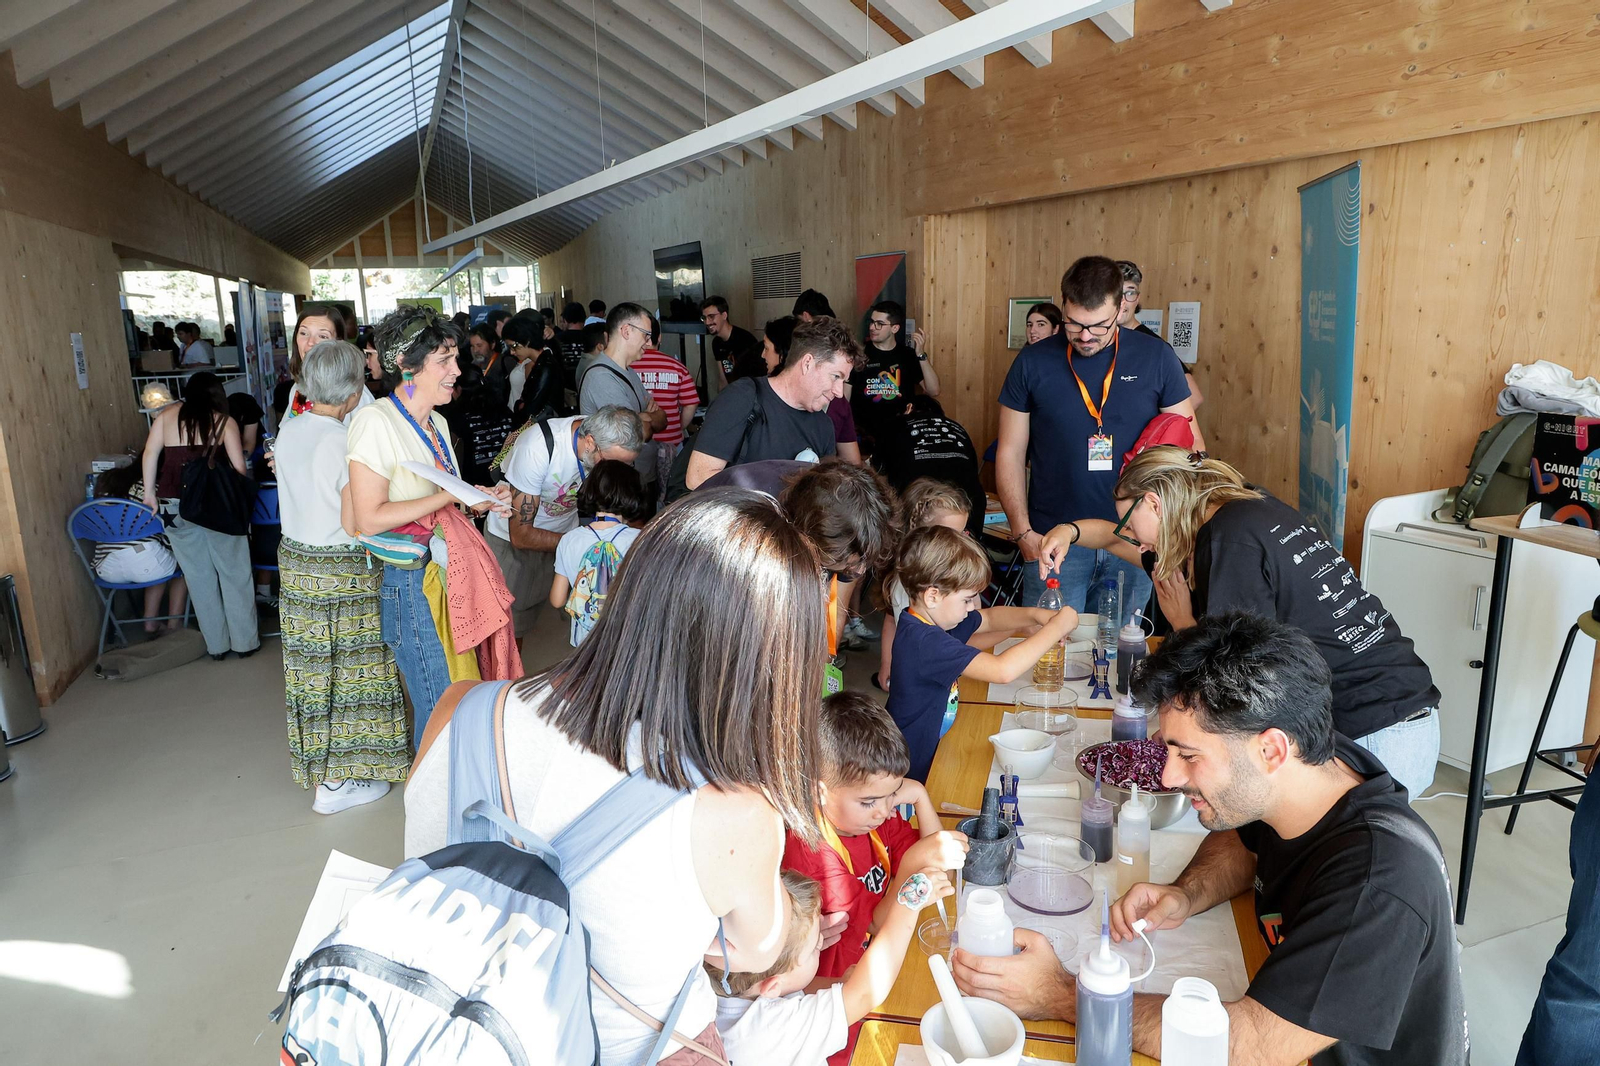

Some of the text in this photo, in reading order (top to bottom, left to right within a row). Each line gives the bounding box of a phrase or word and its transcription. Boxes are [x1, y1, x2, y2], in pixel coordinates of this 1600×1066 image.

[644, 372, 656, 382] THE
[659, 372, 679, 383] MOOD
[1562, 477, 1586, 489] QUE
[1570, 491, 1578, 500] A
